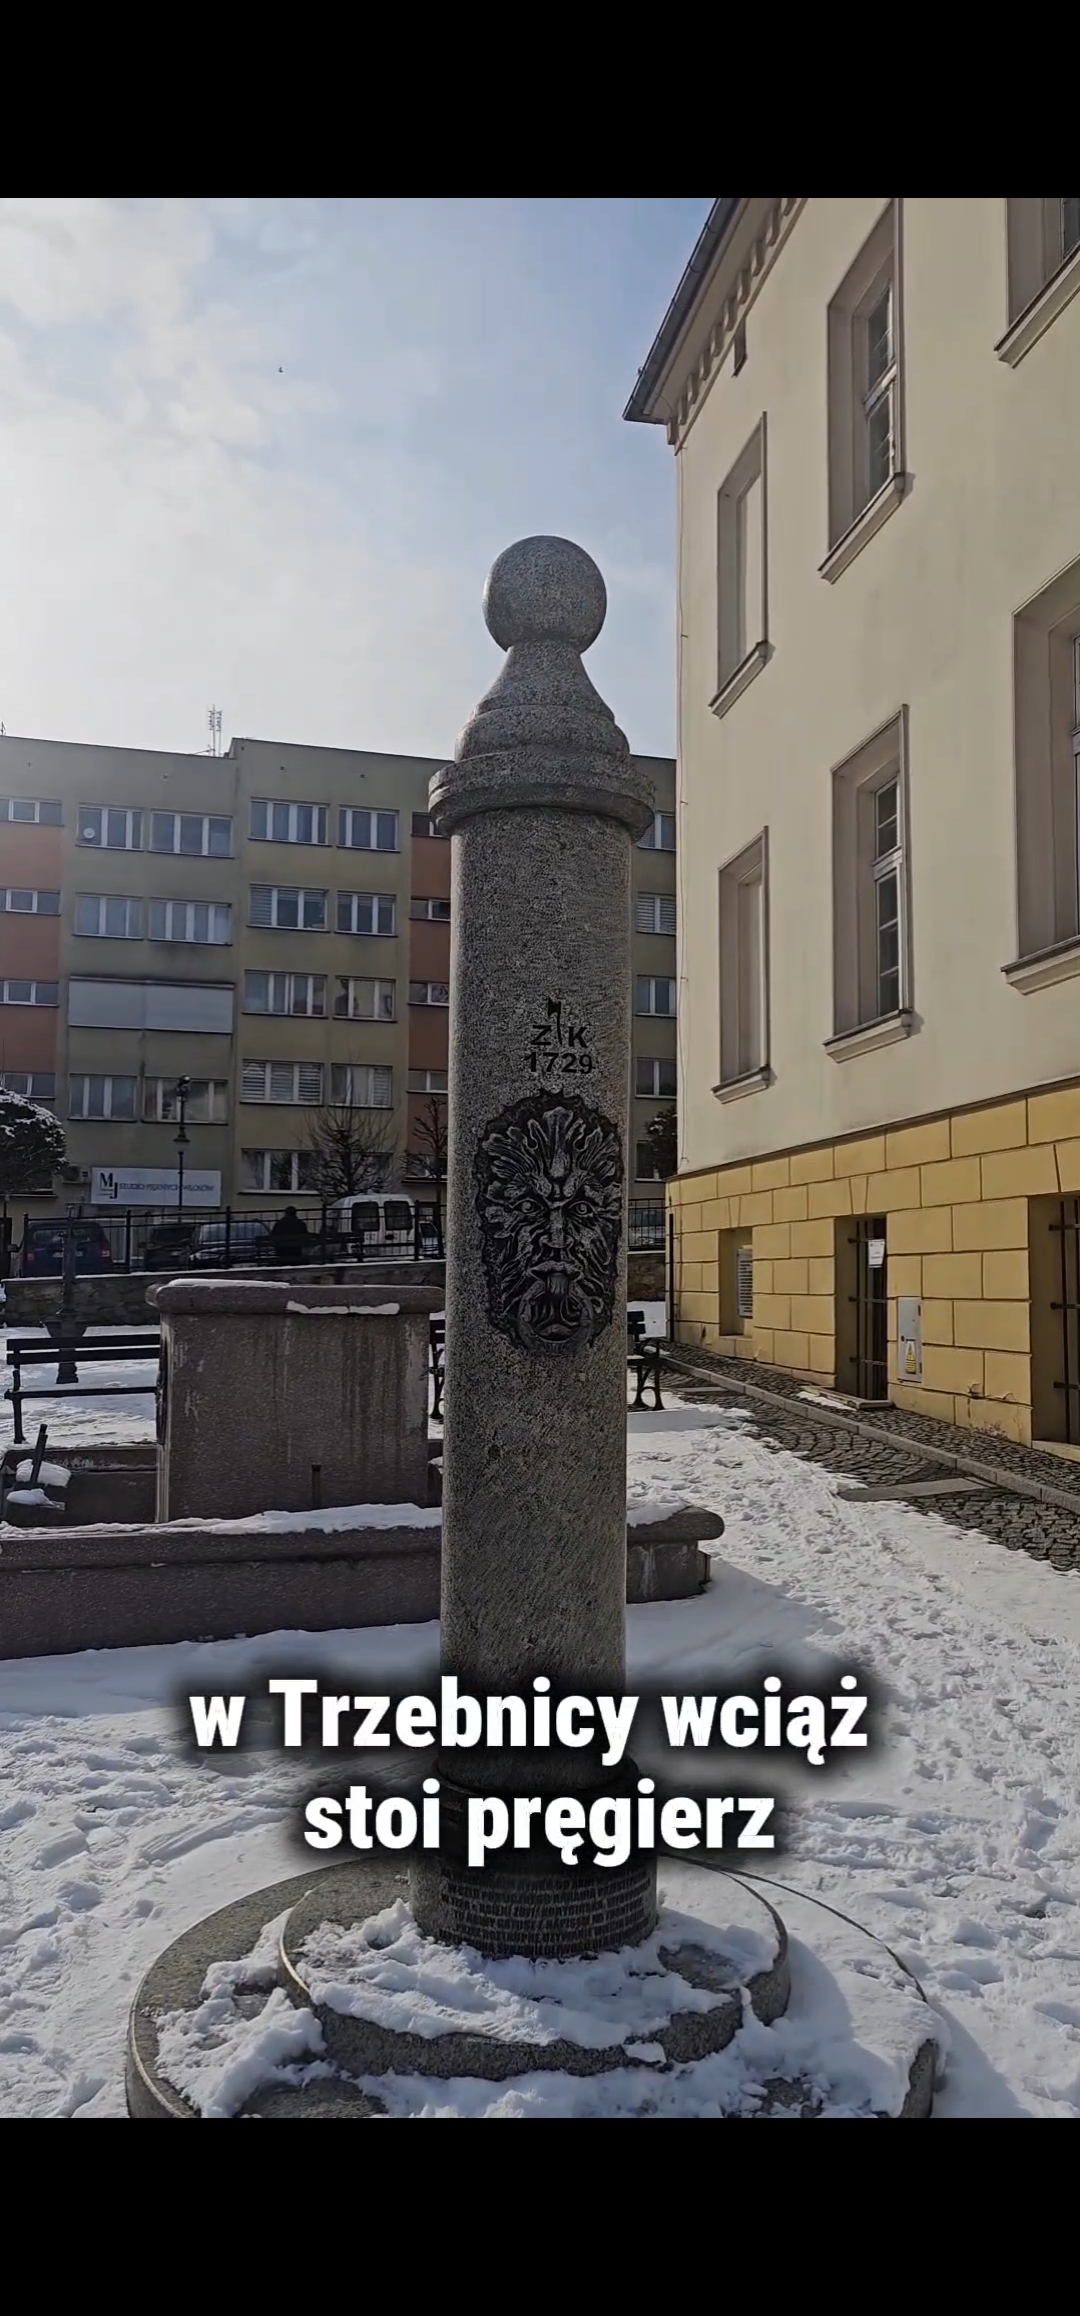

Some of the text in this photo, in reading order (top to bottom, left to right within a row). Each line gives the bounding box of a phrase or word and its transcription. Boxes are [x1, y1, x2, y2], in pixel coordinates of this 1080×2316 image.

[530, 1024, 588, 1048] Z K
[523, 1051, 593, 1075] 1729
[119, 1182, 146, 1191] STUDIO
